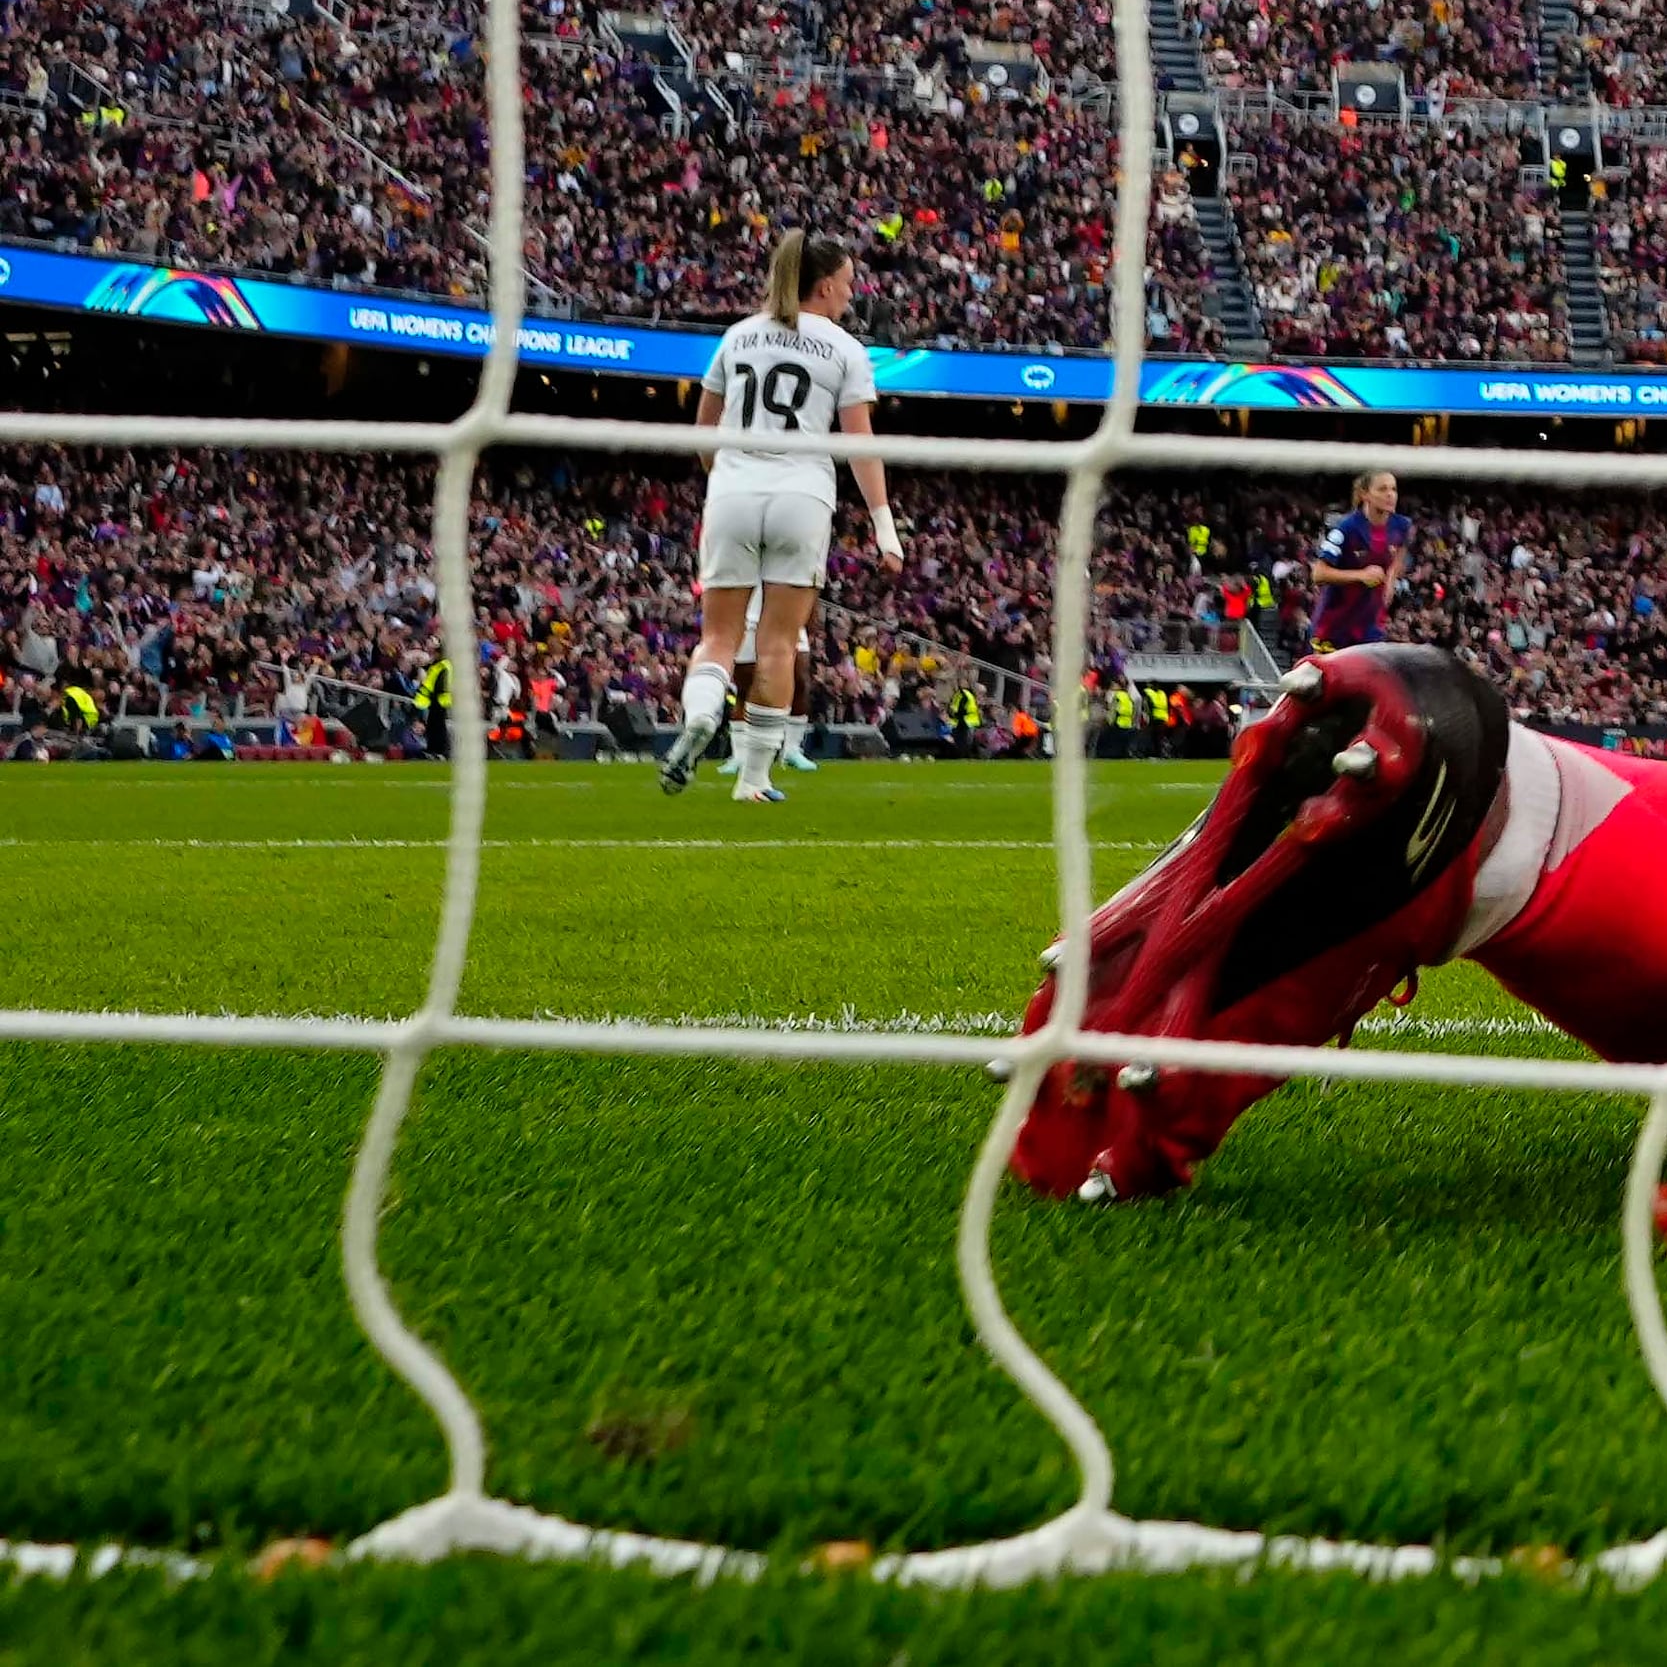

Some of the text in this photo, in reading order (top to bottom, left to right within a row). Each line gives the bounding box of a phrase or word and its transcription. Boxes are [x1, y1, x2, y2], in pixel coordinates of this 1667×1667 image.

[350, 307, 388, 332] UEFA
[466, 322, 562, 353] CHAPIONS
[566, 334, 634, 360] LEAGUE
[765, 333, 834, 361] NAVARRO
[735, 361, 812, 453] 19
[1480, 381, 1531, 401] UEFA
